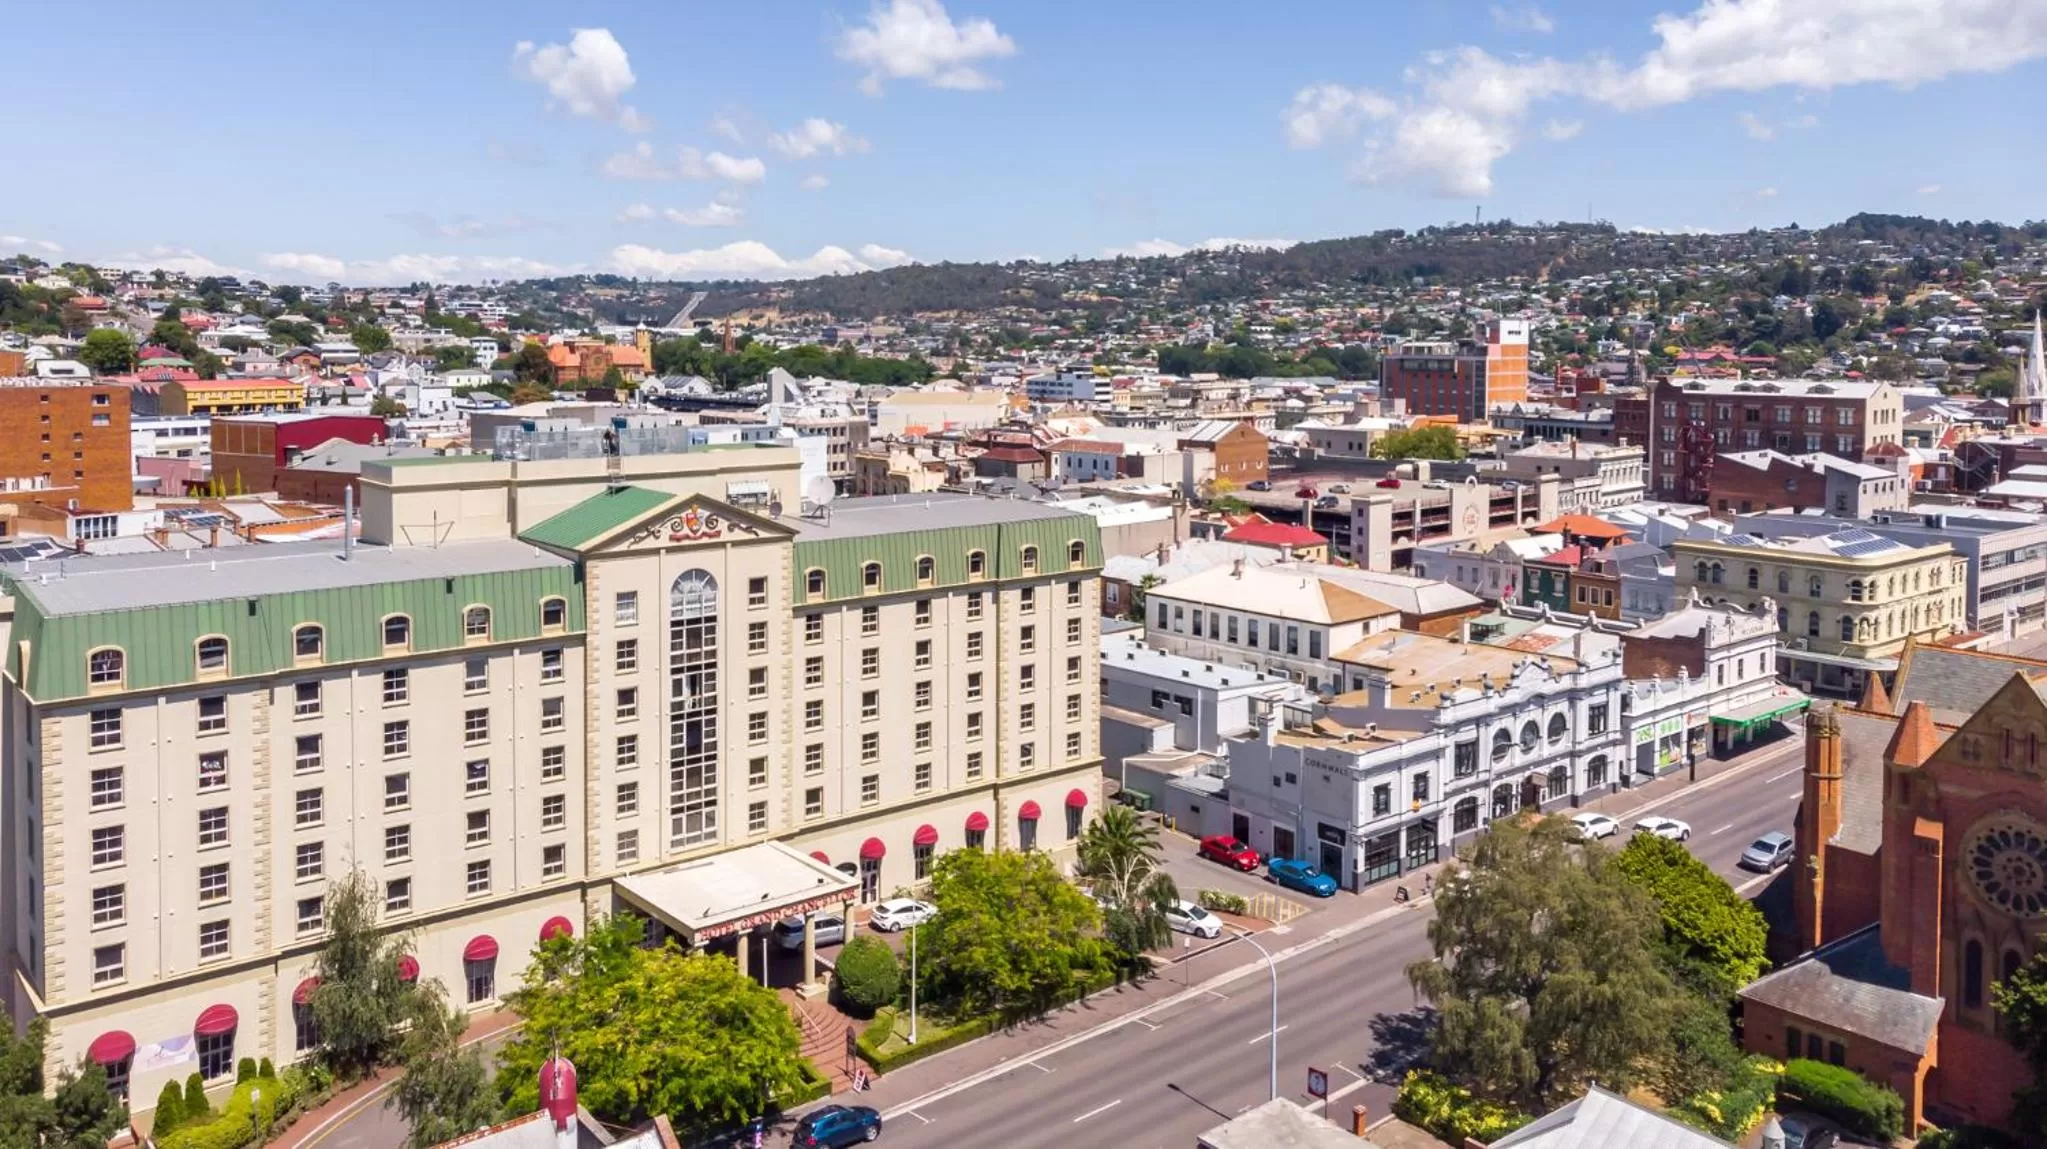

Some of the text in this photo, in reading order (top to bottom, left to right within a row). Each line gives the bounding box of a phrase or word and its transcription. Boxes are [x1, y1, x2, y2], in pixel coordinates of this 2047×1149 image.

[700, 889, 857, 941] HOTEL GRAND CHANCELLOR
